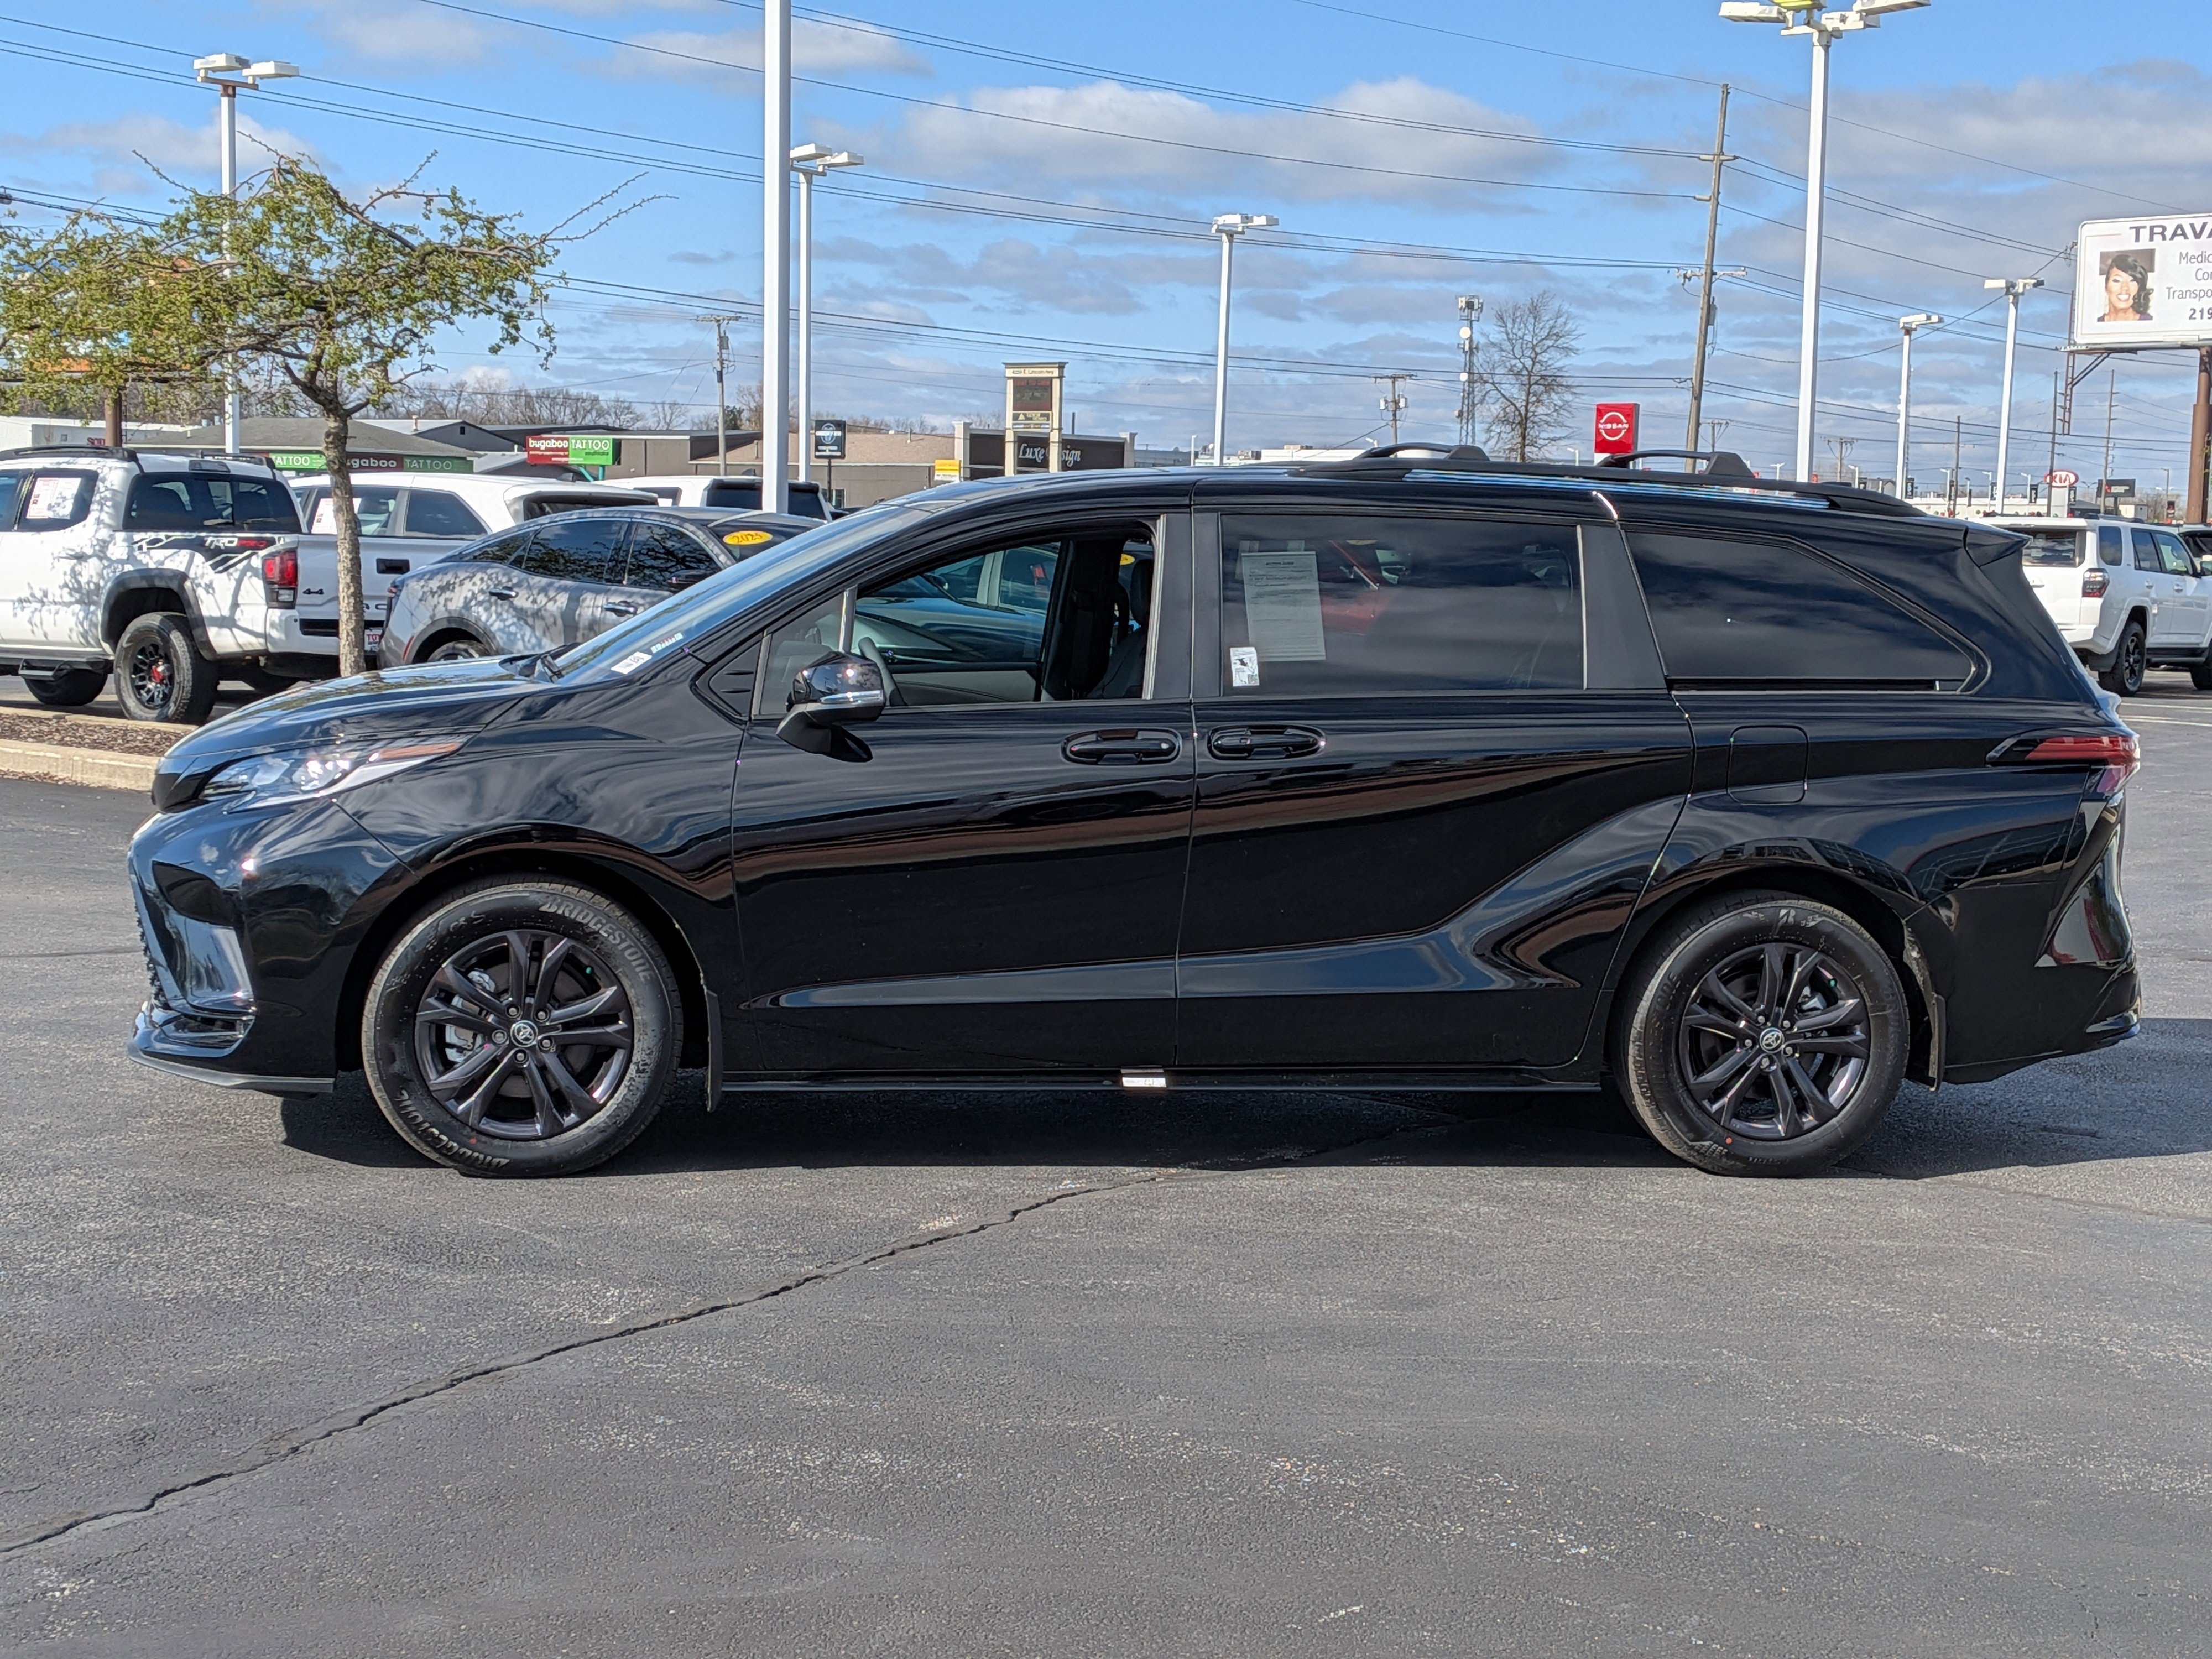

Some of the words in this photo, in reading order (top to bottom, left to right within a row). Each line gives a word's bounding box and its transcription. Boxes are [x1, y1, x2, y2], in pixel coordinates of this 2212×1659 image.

[2129, 222, 2212, 242] TRAV
[528, 438, 567, 450] bugaboo
[571, 440, 609, 450] TATTOO
[1018, 443, 1045, 462] Luxe
[405, 459, 452, 470] TATTOO
[2052, 474, 2071, 484] KIA
[539, 899, 651, 984] BRIDGESTONE
